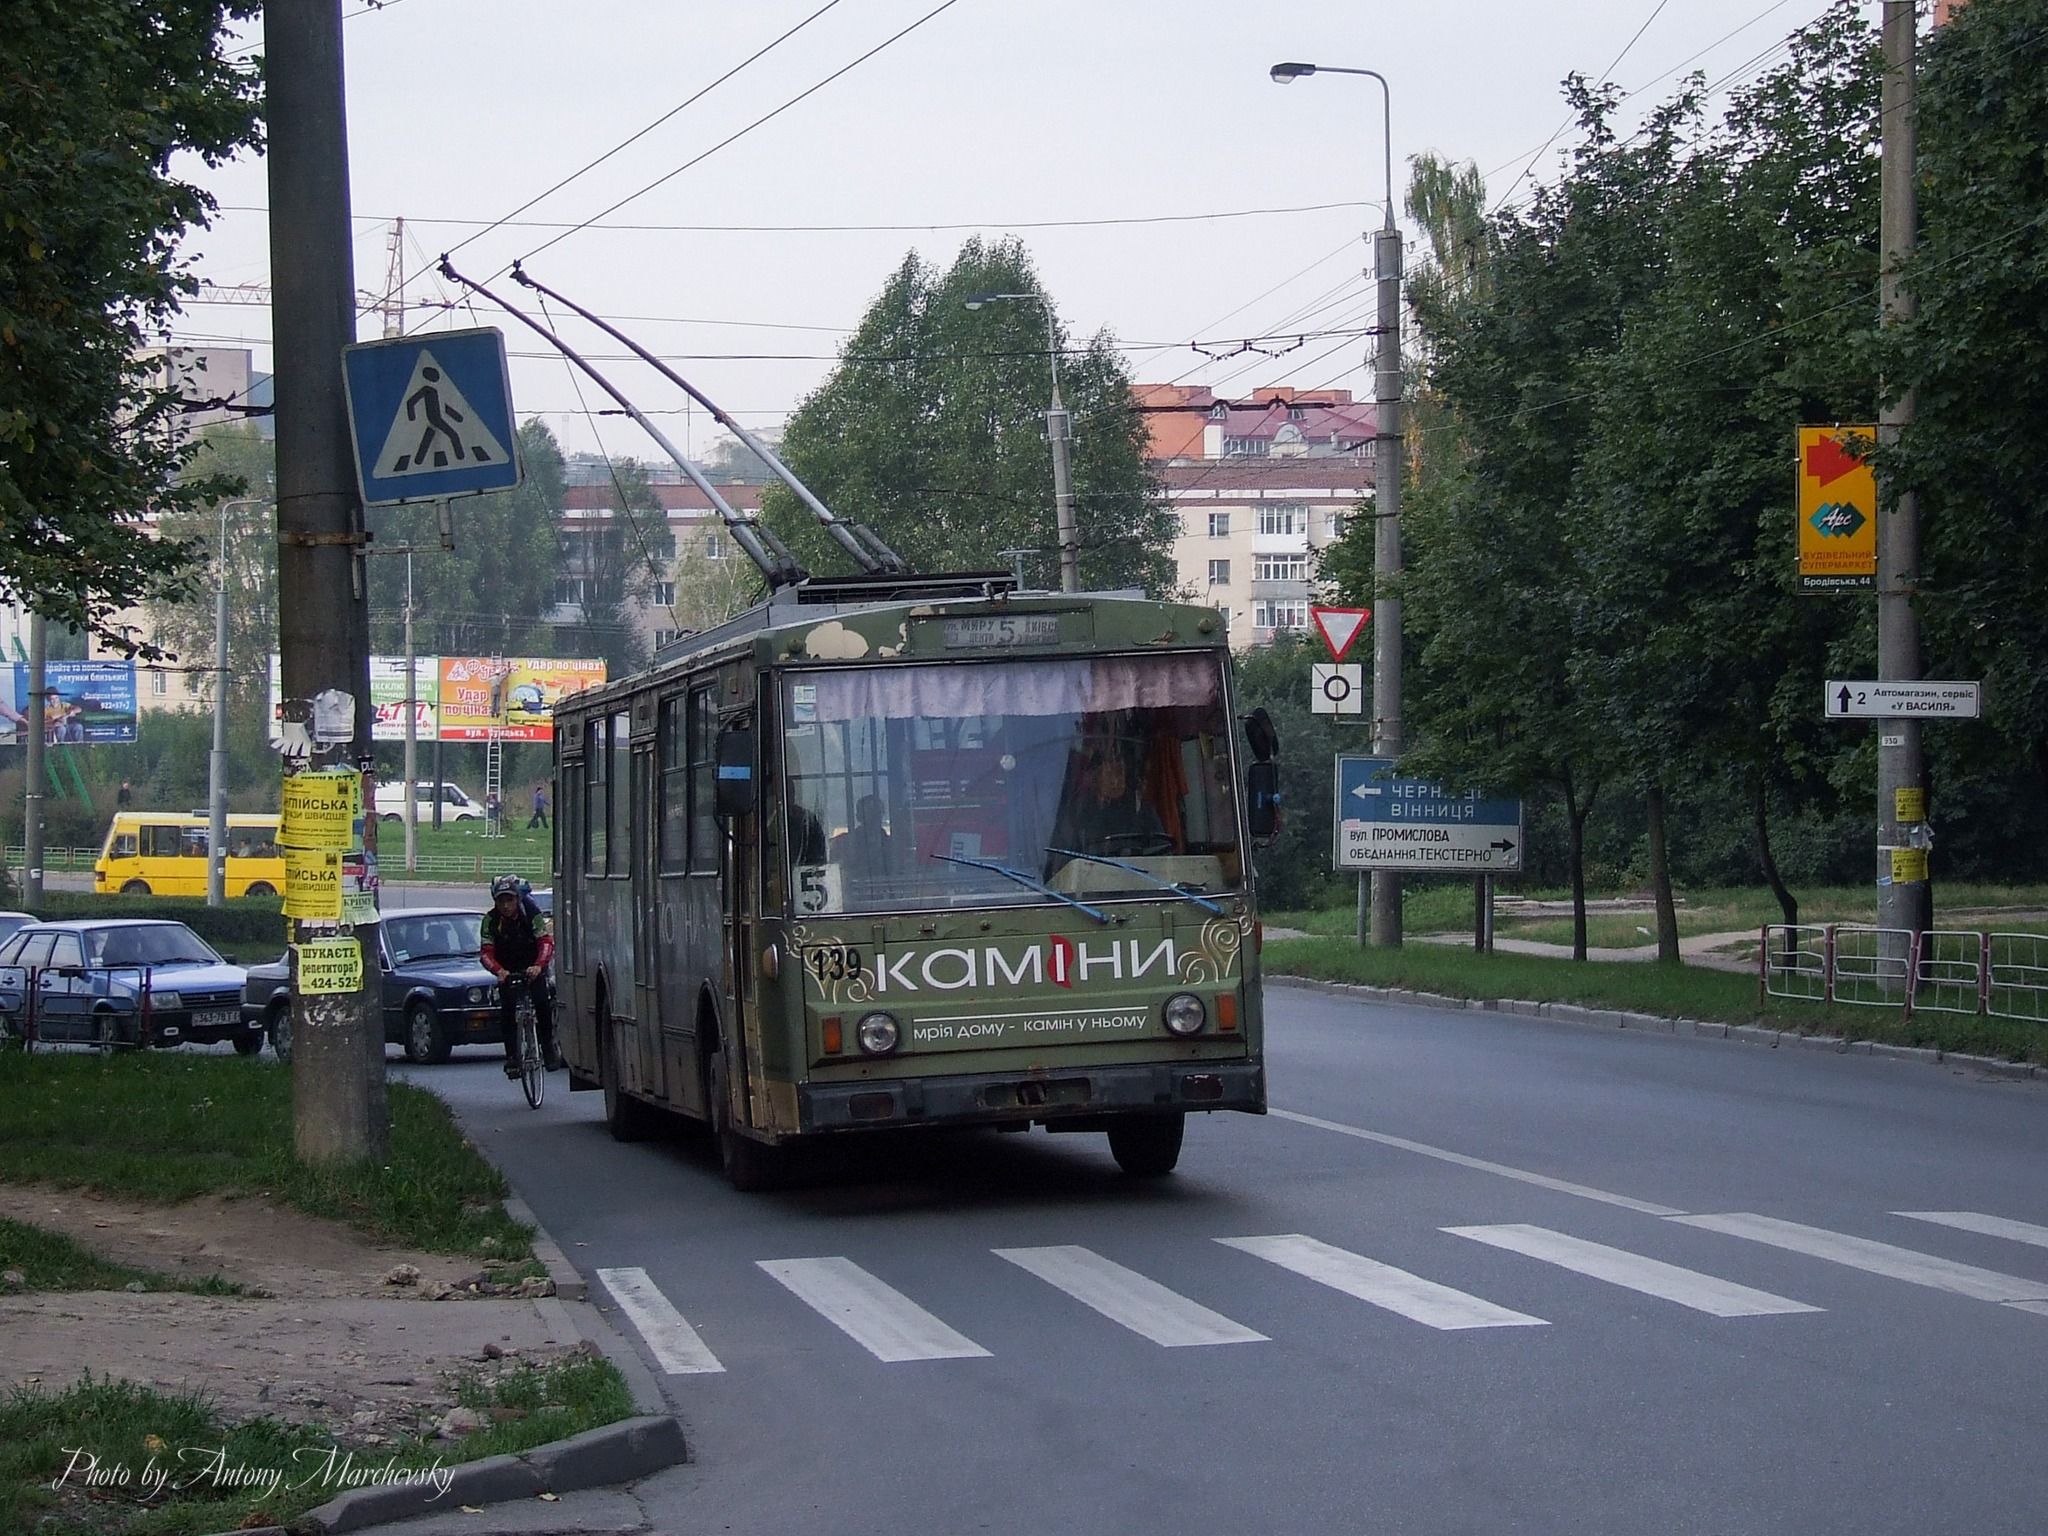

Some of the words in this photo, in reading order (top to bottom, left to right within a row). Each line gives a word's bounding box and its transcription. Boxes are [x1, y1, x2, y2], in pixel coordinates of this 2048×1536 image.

[1803, 551, 1872, 560] БУДІВЕЛЬНИЙ
[1802, 561, 1873, 569] СУПЕРМАРКЕТ
[1803, 577, 1858, 587] Бродівська,
[1860, 577, 1871, 585] 44
[997, 620, 1015, 645] 5
[527, 659, 552, 672] Удар
[556, 661, 571, 670] по
[575, 659, 605, 672] цінах!
[457, 688, 487, 701] Удар
[1857, 692, 1866, 705] 2
[1873, 688, 1939, 699] Автомагазин,
[1942, 690, 1974, 699] сервіс
[444, 705, 460, 716] по
[463, 704, 490, 717] ціна
[1906, 702, 1955, 711] ВАСИЛЯ»
[1391, 784, 1482, 802] ЧЕРНЦІ
[1391, 803, 1474, 821] ВІННИЦЯ
[1372, 828, 1450, 842] ПРОМИСЛОВА
[800, 869, 828, 912] 5
[302, 947, 356, 958] ШУКАЄТЕ
[302, 961, 358, 976] репетитора?
[815, 948, 862, 982] 139
[913, 1023, 953, 1042] мрія
[957, 1022, 1005, 1039] дому
[1023, 1017, 1073, 1032] камін
[1077, 1018, 1087, 1032] у
[1091, 1015, 1147, 1030] ньому
